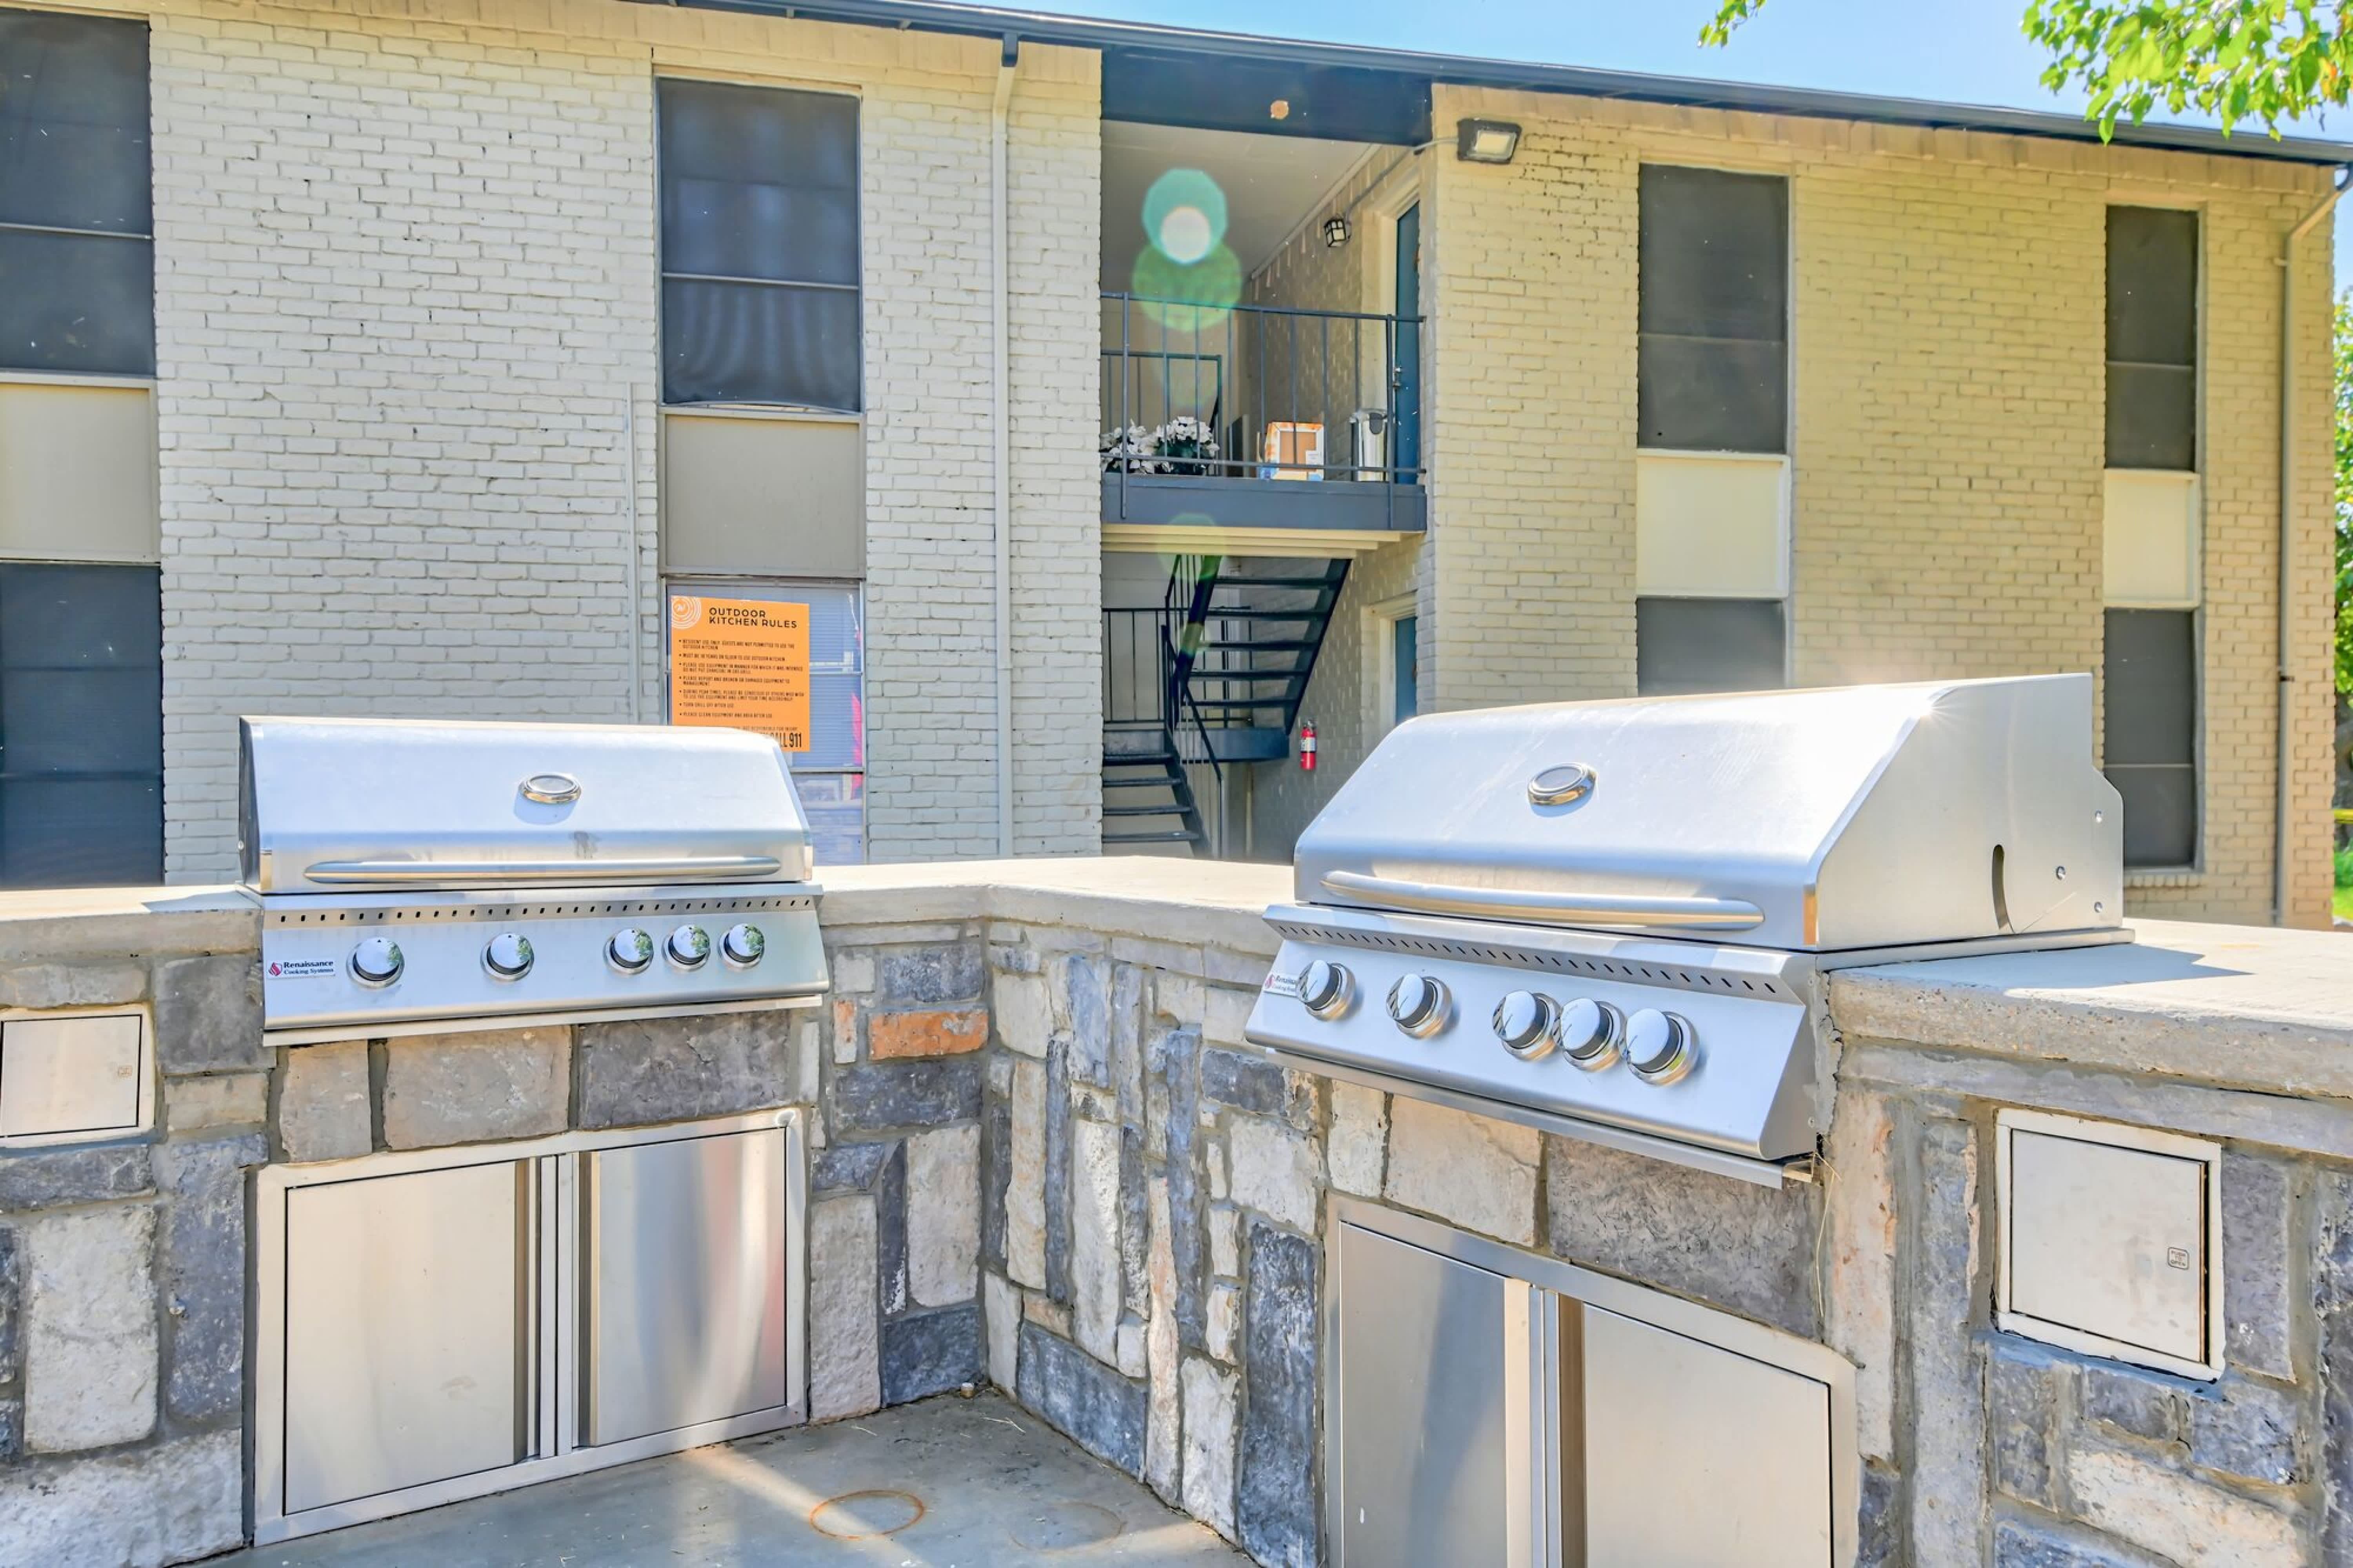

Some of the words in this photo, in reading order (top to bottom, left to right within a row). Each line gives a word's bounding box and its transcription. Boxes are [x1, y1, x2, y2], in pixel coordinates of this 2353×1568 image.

[709, 607, 766, 618] OUTDOOR
[709, 616, 758, 626] KITCHEN
[762, 618, 797, 628] RULES
[789, 732, 802, 747] 911
